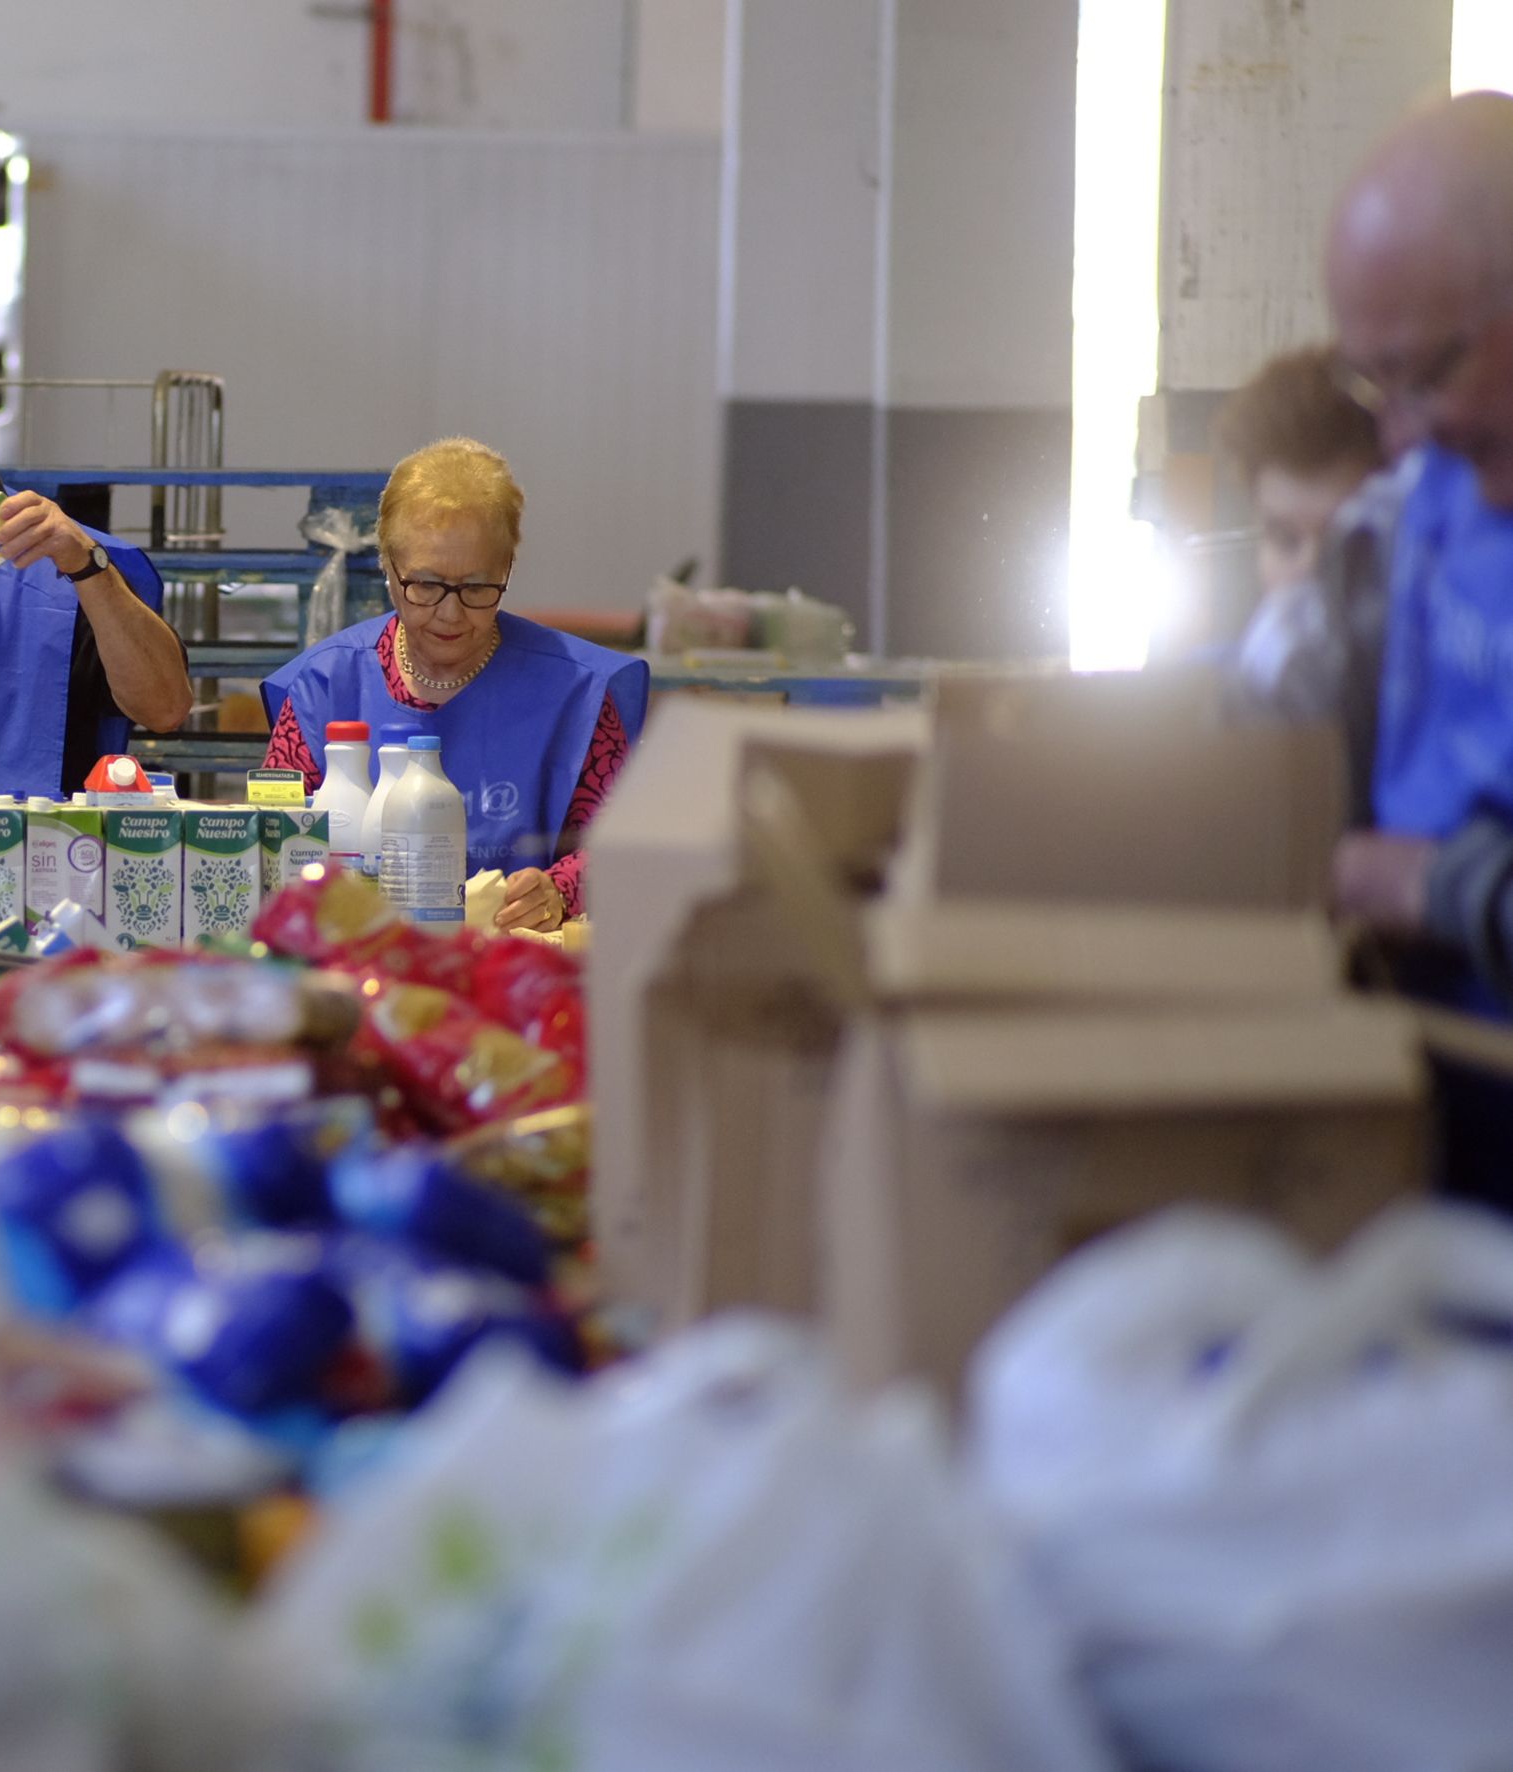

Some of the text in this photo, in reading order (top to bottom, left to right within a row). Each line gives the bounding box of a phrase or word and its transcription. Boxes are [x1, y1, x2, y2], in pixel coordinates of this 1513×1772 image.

[121, 816, 168, 828] Campo
[199, 816, 245, 828] Campo
[118, 827, 170, 839] Nuestro
[196, 827, 247, 839] Nuestro
[289, 849, 323, 859] Campo
[469, 845, 518, 858] ENTOS
[31, 851, 57, 867] sin
